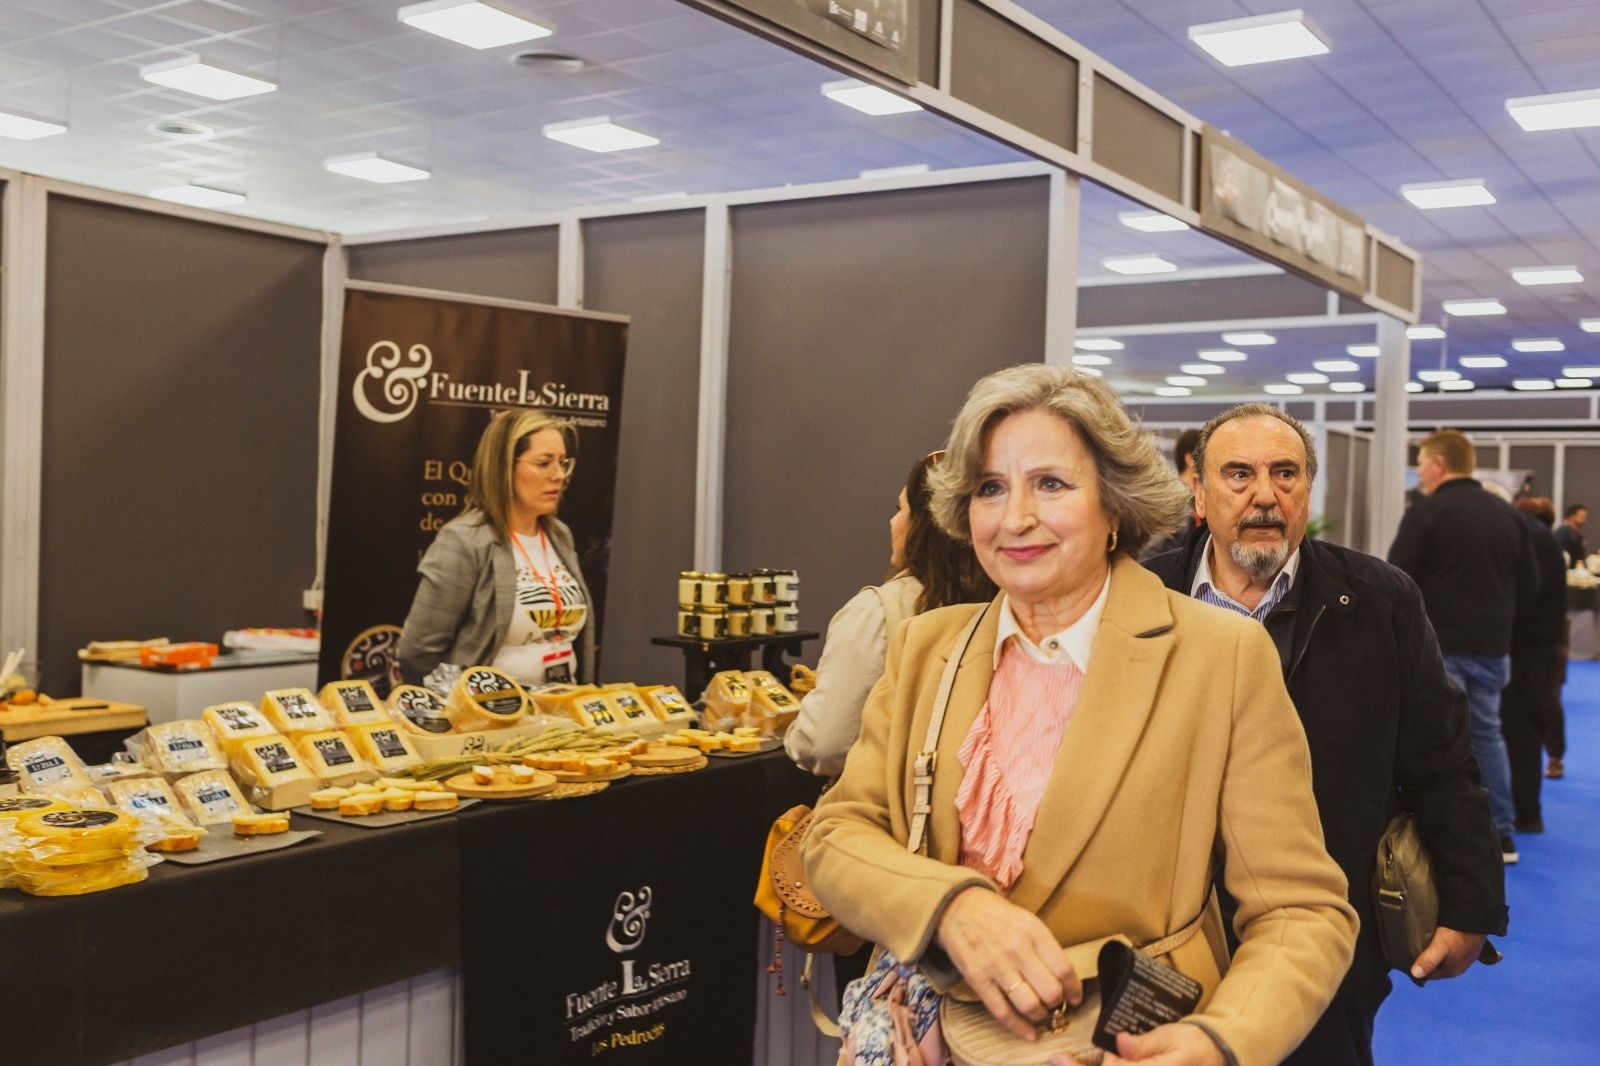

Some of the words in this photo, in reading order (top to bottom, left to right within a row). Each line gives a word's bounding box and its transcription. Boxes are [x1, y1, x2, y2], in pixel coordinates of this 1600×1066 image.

[430, 371, 517, 402] Fuente
[542, 380, 610, 411] Sierra
[424, 459, 443, 481] El
[421, 491, 457, 506] con
[566, 979, 618, 1019] Fuente
[648, 959, 691, 987] Sierra
[615, 1003, 652, 1020] Sabor
